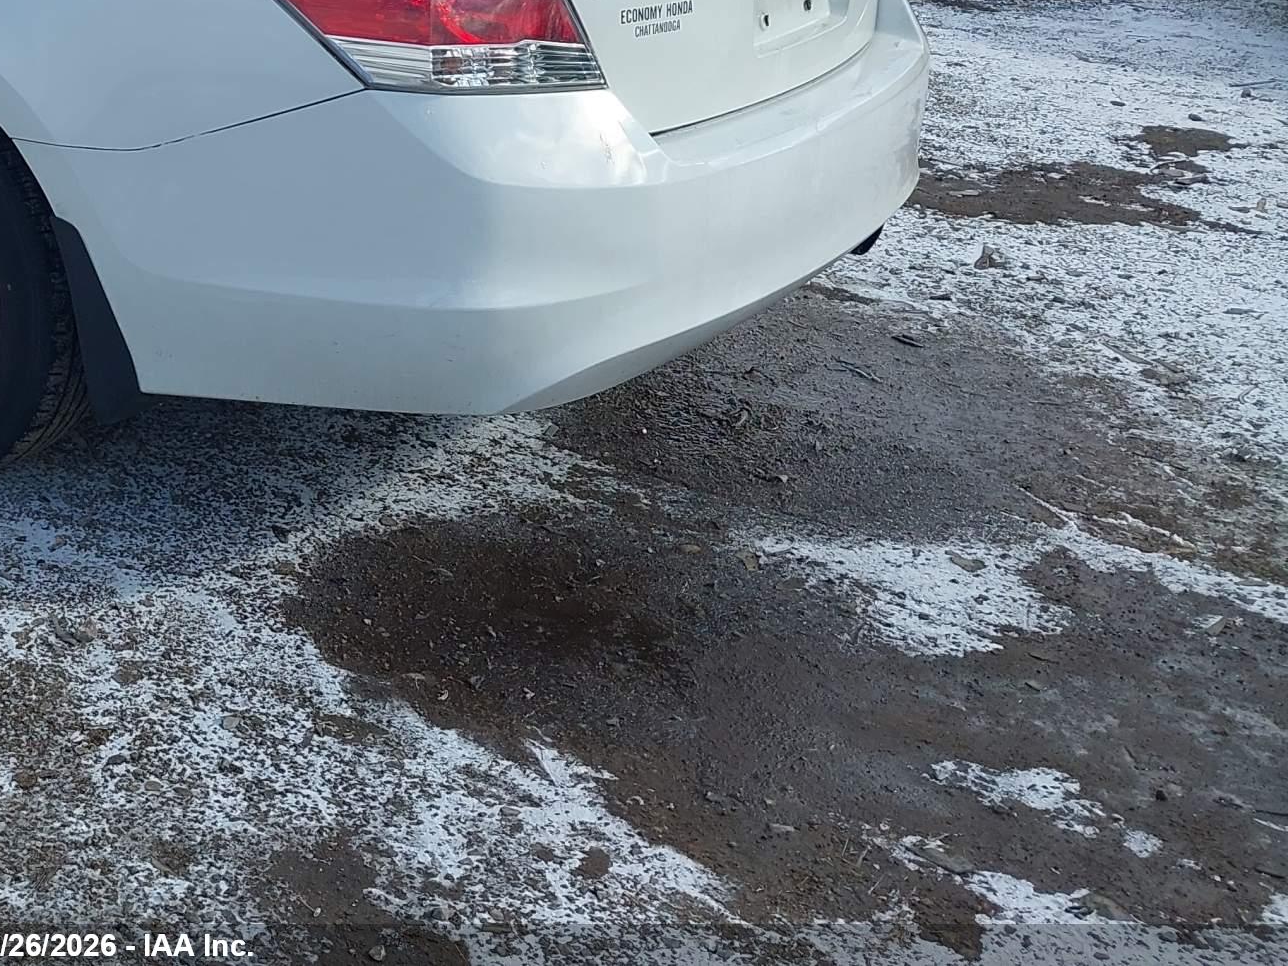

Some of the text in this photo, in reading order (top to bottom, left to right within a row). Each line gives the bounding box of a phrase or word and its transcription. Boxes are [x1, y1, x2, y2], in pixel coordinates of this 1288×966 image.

[620, 0, 693, 24] ECONOMY HONDA
[634, 19, 681, 38] CHATTANOOGA
